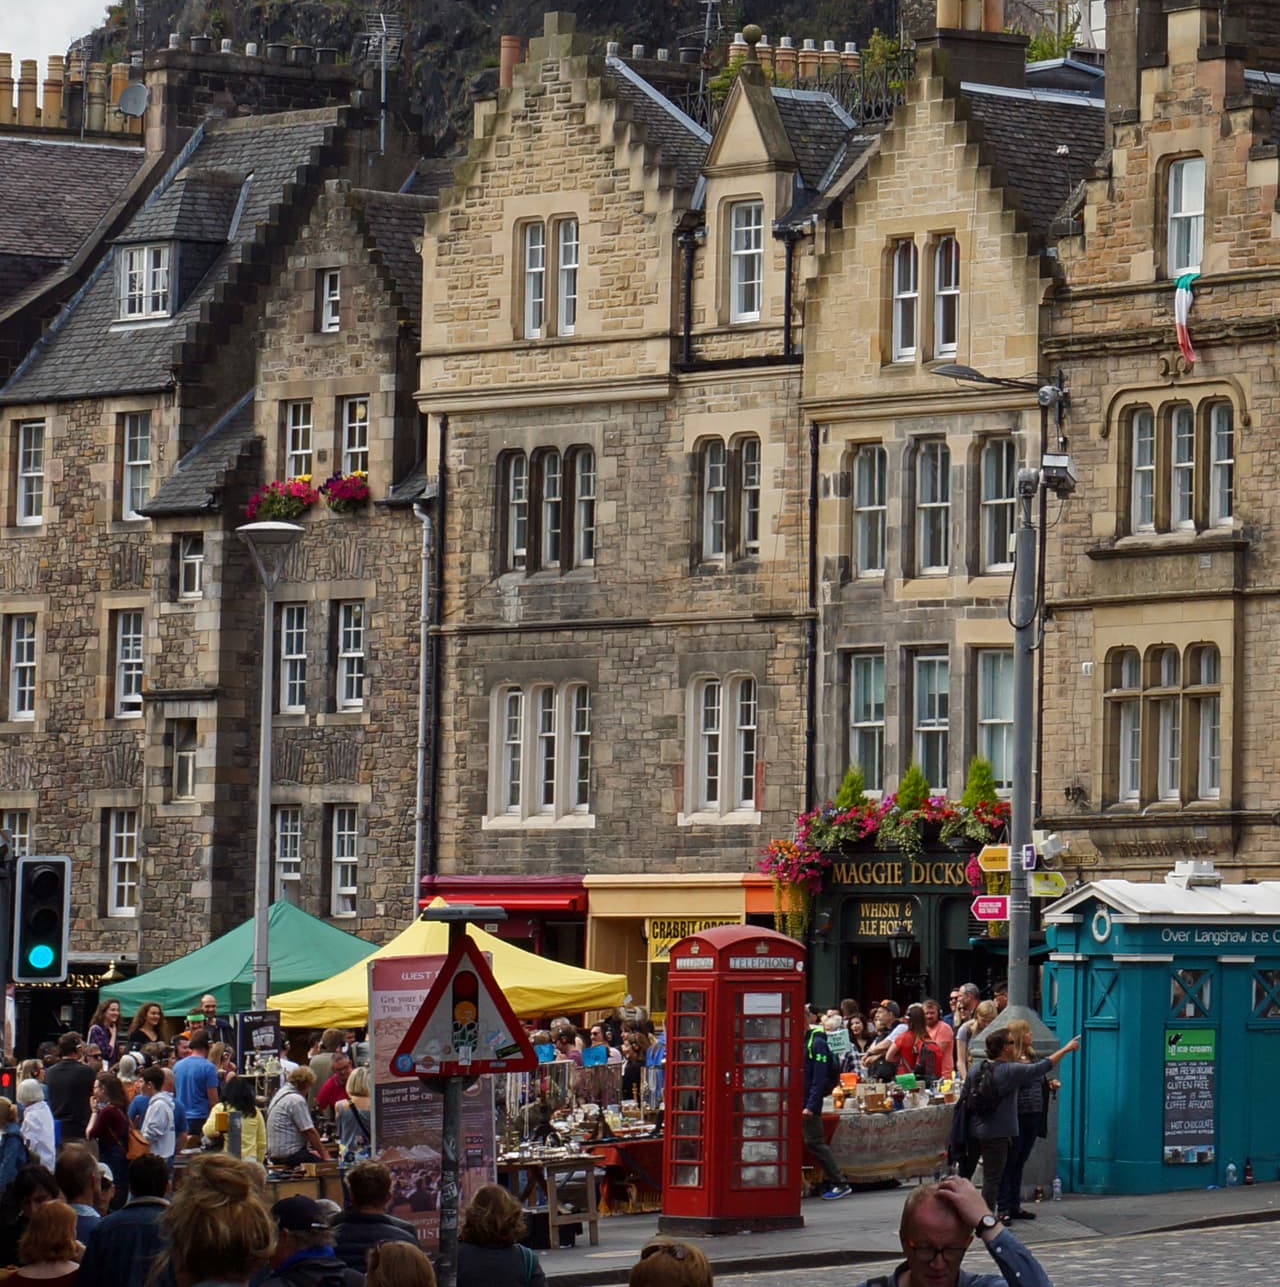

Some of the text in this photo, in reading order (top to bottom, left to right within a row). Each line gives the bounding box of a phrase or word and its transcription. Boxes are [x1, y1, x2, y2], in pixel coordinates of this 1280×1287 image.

[832, 862, 904, 885] MAGGIE
[860, 902, 912, 918] WHISKY &
[652, 920, 697, 940] CRABBIT
[858, 920, 878, 936] ALE
[1161, 928, 1192, 943] Over
[1194, 928, 1248, 946] Langshaw
[1251, 929, 1269, 943] Ice
[733, 958, 793, 969] TELEPHONE
[66, 973, 101, 988] DROP
